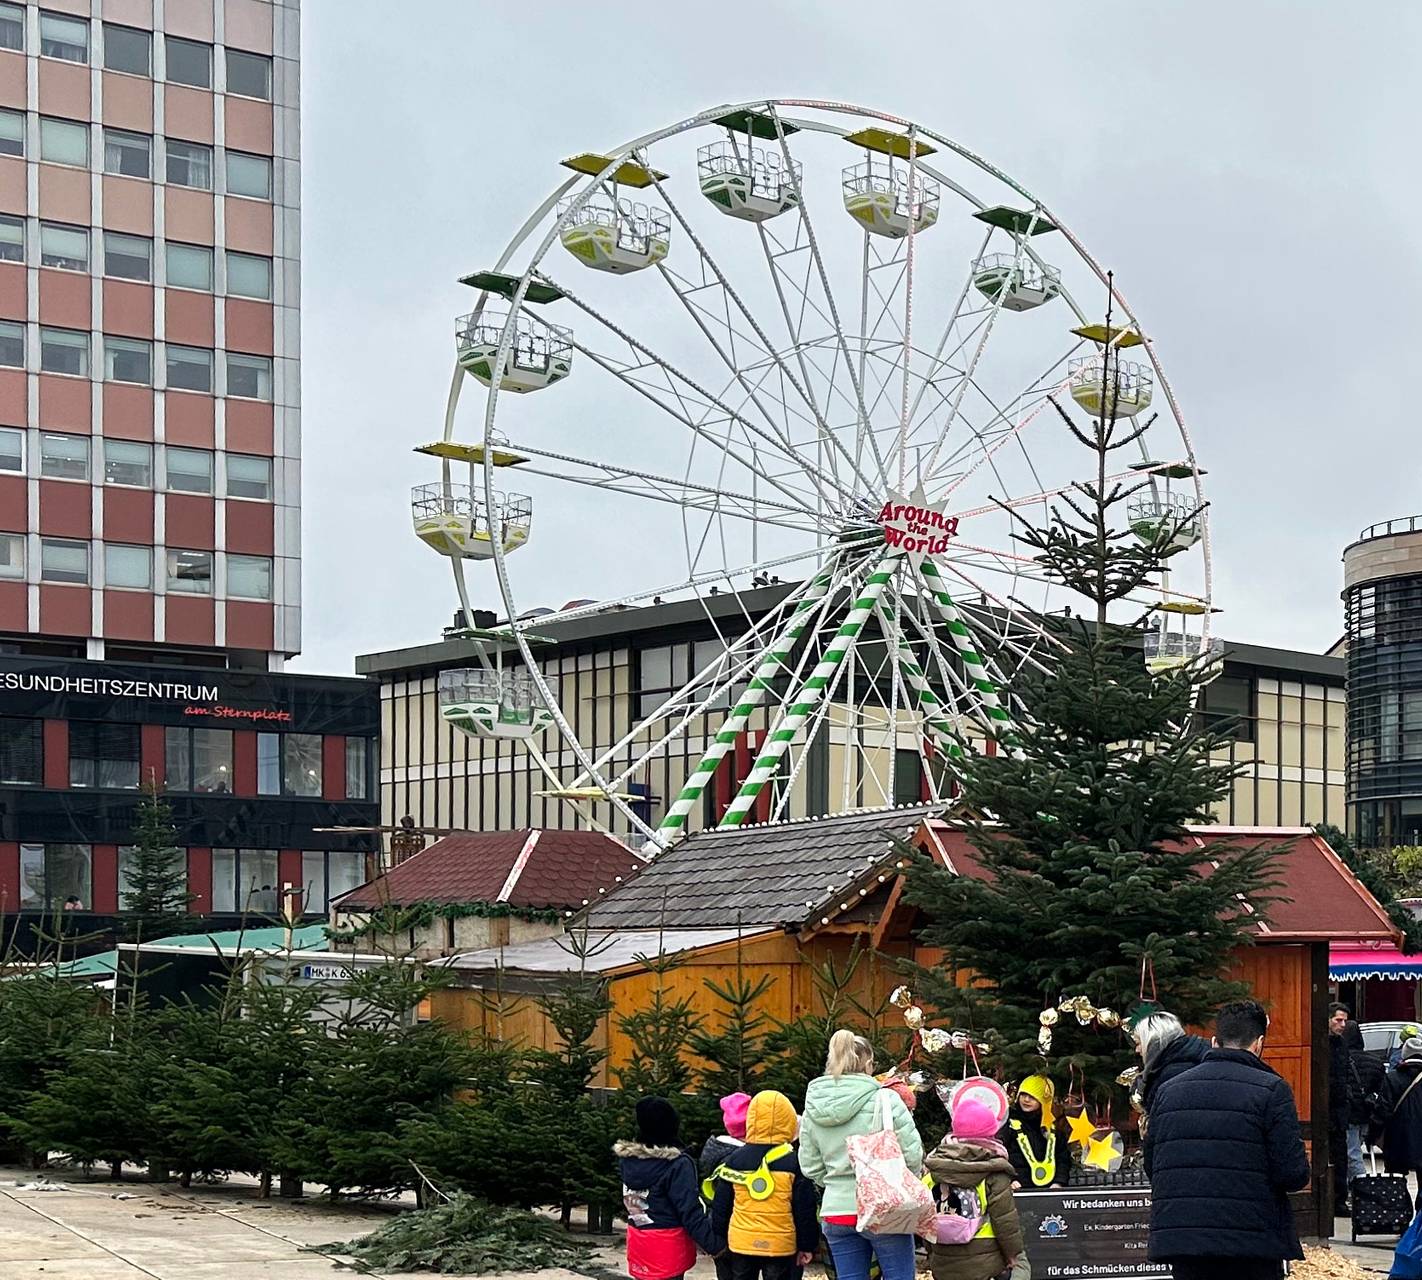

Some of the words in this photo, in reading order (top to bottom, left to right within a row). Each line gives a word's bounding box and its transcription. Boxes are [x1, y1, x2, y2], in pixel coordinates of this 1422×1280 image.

[876, 500, 960, 536] Around
[907, 521, 929, 536] the
[884, 524, 950, 554] World
[184, 706, 209, 715] am
[213, 705, 291, 721] Sternplatz
[1062, 1199, 1079, 1209] Wir
[1080, 1199, 1125, 1209] bedanken
[1126, 1199, 1144, 1208] uns
[1094, 1223, 1134, 1232] Kindergarten
[1047, 1265, 1061, 1275] für
[1063, 1265, 1081, 1275] das
[1081, 1263, 1135, 1274] Schmücken
[1136, 1263, 1167, 1273] dieses
